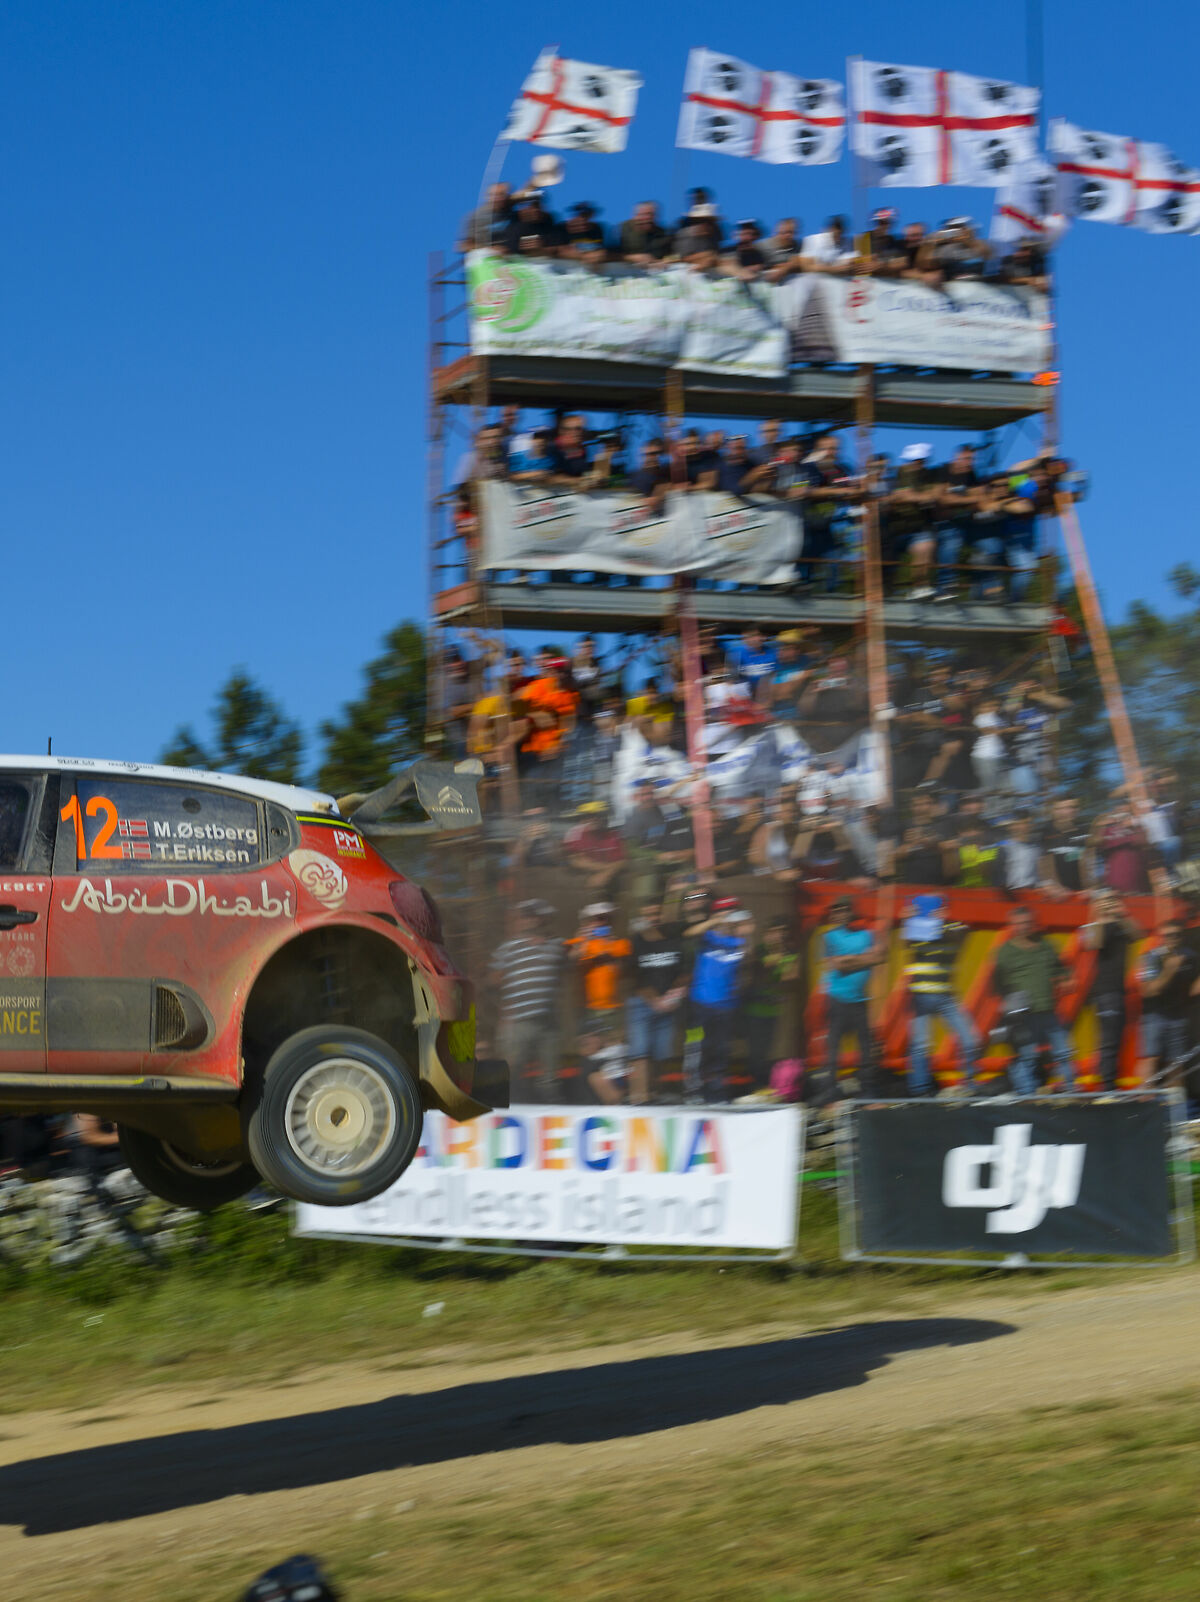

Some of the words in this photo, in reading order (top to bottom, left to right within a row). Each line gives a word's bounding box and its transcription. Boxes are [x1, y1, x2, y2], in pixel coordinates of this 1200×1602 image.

[60, 795, 123, 861] 12
[153, 820, 259, 844] M.Østberg
[333, 830, 365, 849] PMI
[155, 842, 251, 864] T.Eriksen
[356, 1173, 550, 1232] endless
[561, 1178, 728, 1237] island
